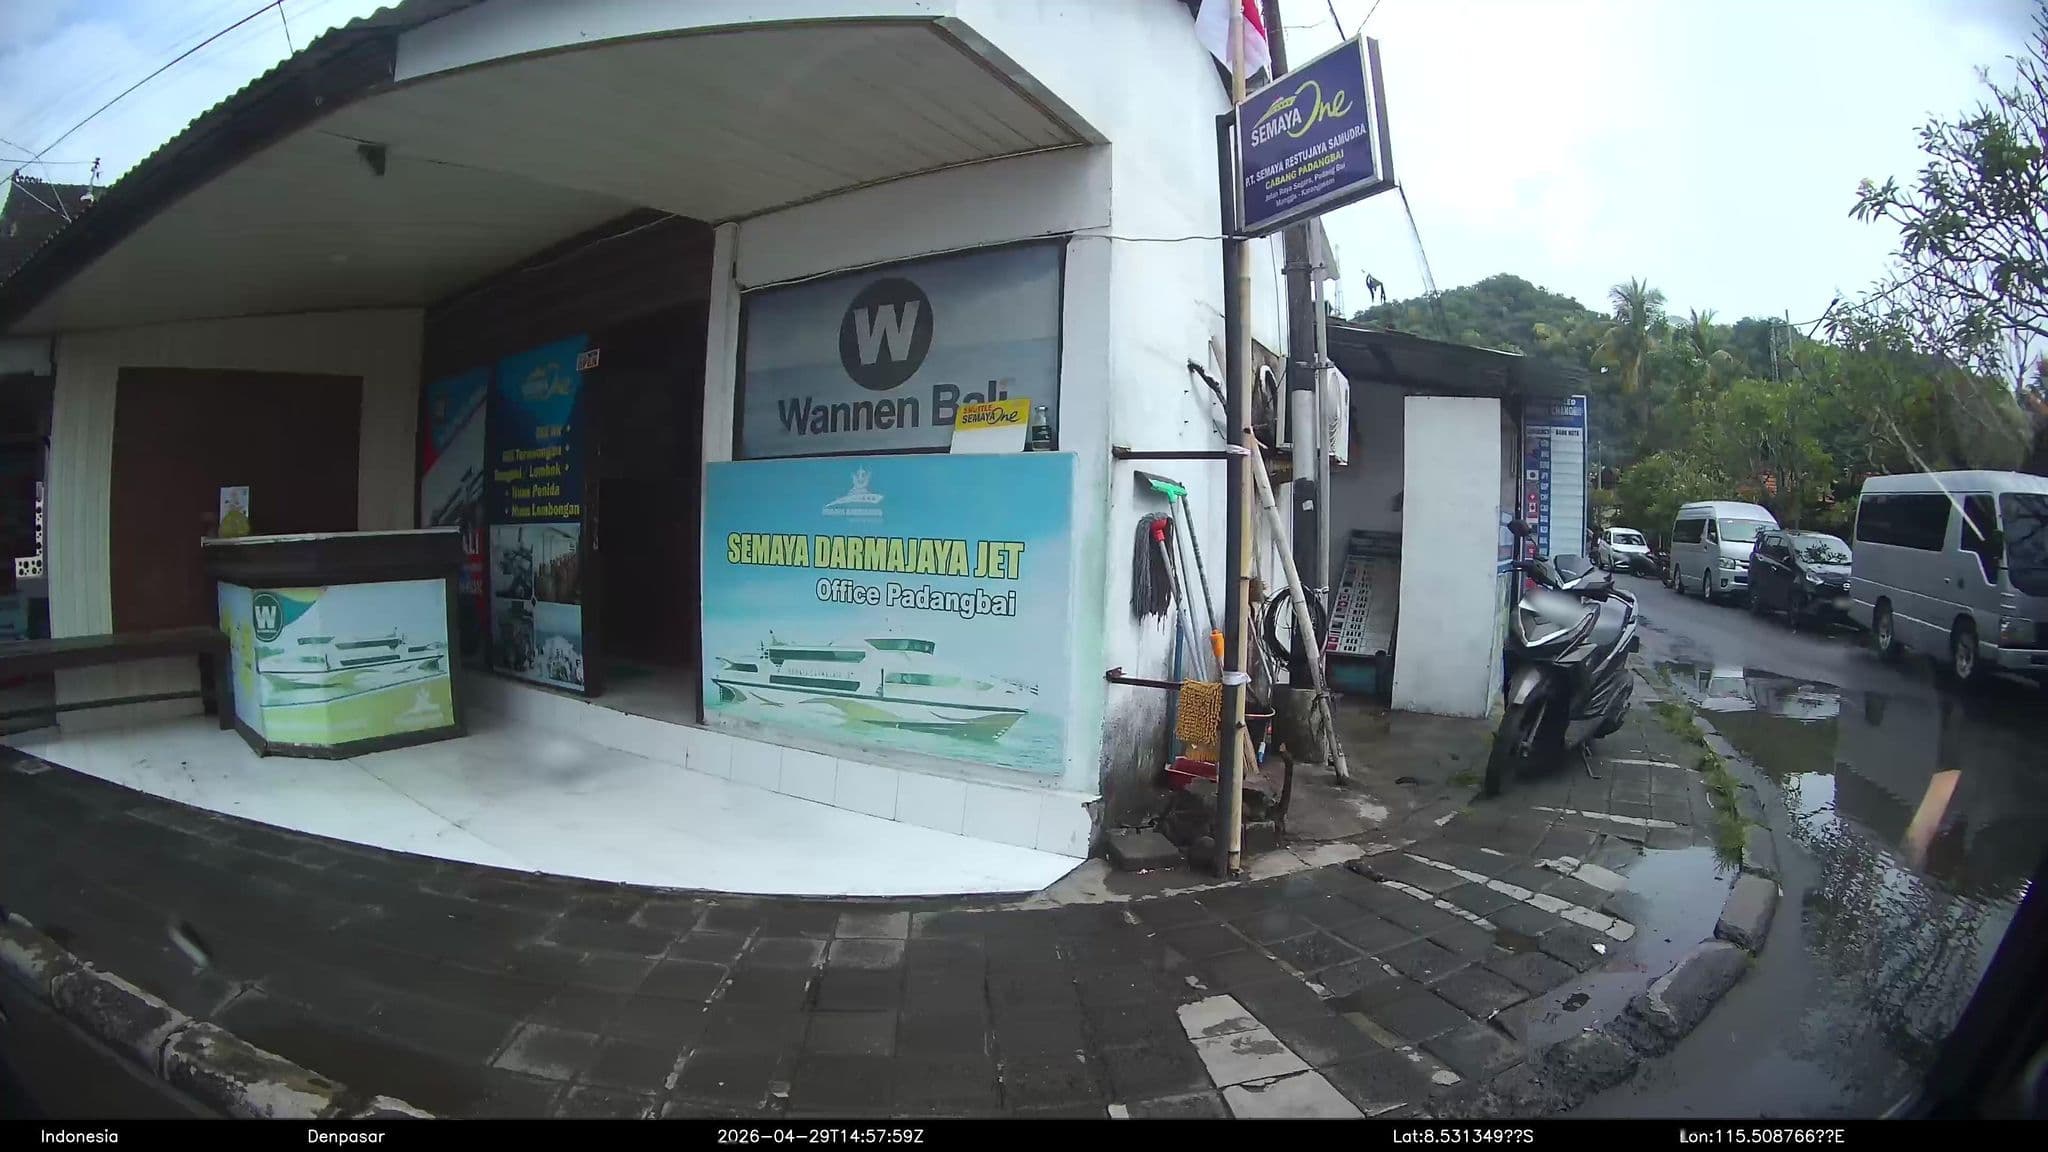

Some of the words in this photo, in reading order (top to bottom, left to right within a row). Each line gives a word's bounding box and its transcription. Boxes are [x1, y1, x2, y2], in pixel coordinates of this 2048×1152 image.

[1250, 107, 1303, 147] SEMAYA
[1287, 79, 1354, 138] One
[1256, 161, 1284, 183] SEMAYA
[1284, 141, 1328, 170] RESTUJAYA
[1328, 122, 1367, 151] SAMUDRA
[1264, 170, 1298, 191] CABANG
[1297, 148, 1345, 177] PADANGBAI
[853, 299, 921, 367] W
[777, 393, 920, 436] Wannen
[962, 411, 996, 424] SEMAYA
[987, 406, 1021, 425] One
[531, 482, 560, 498] Penida
[531, 501, 580, 518] Lembongan
[726, 531, 811, 569] SEMAYA
[813, 534, 969, 578] DARMAJAYA
[973, 541, 1026, 581] JET
[254, 605, 277, 629] W
[815, 577, 881, 606] Office
[886, 582, 1017, 619] Padangbai
